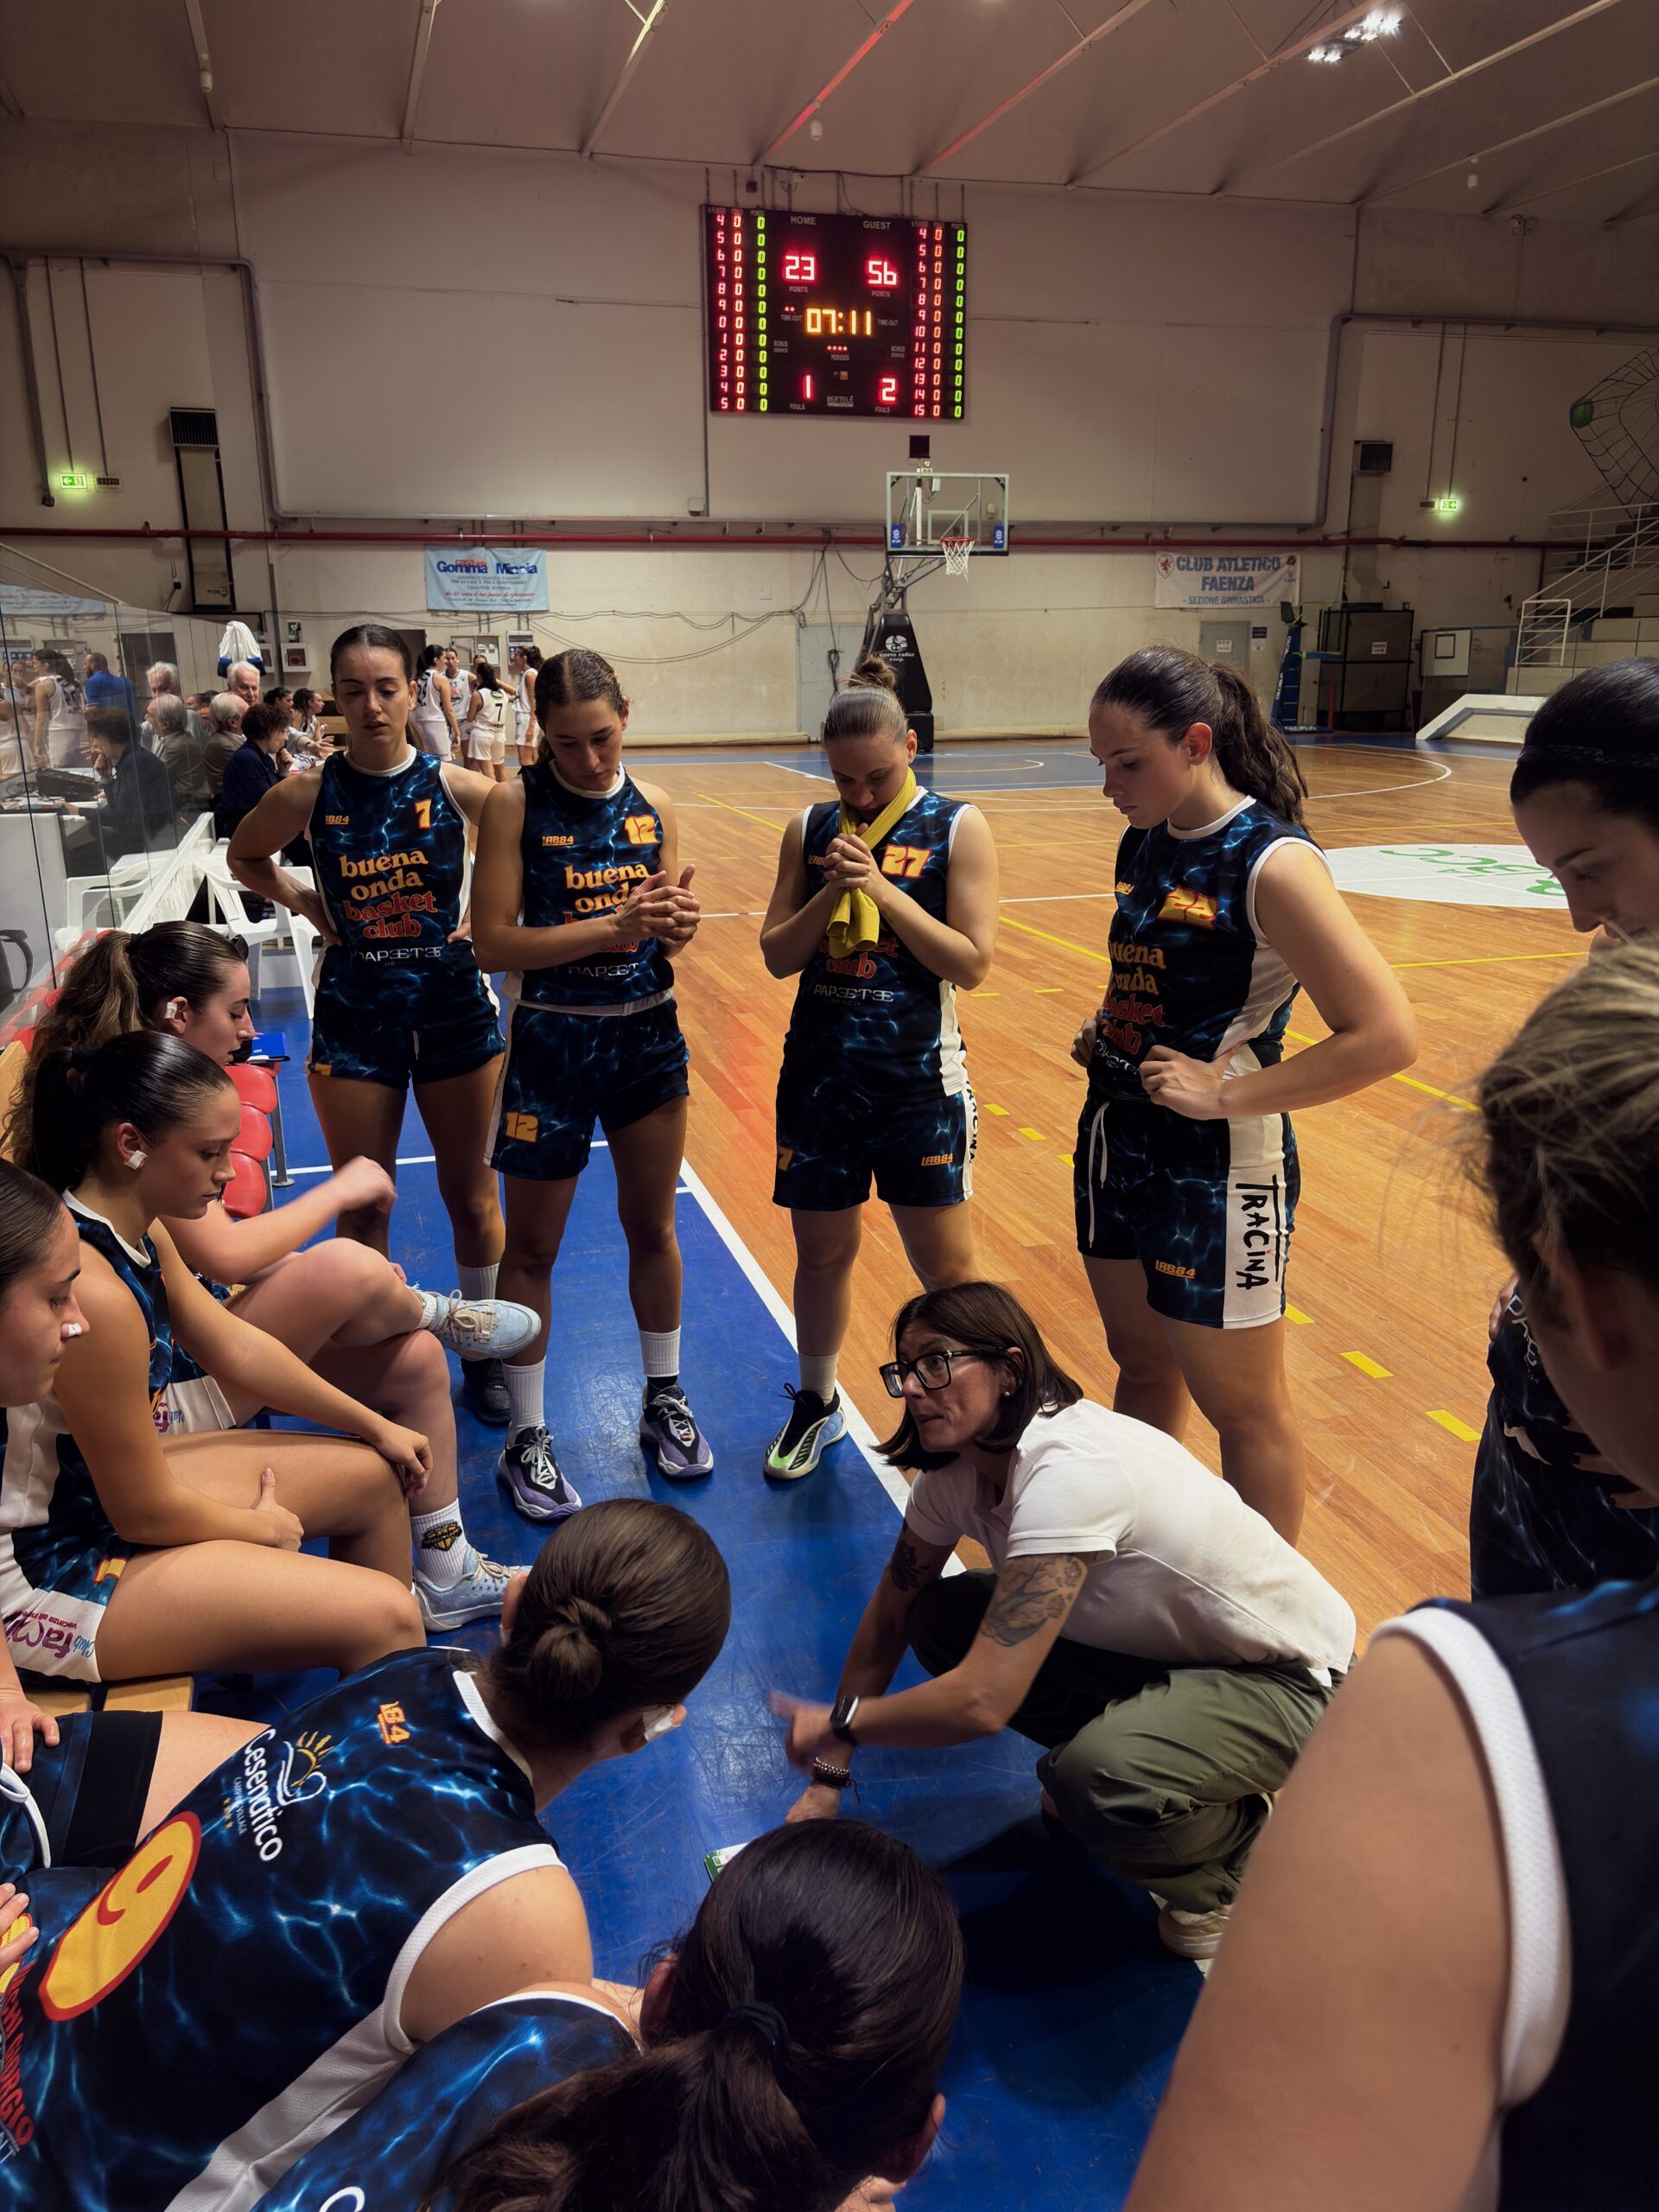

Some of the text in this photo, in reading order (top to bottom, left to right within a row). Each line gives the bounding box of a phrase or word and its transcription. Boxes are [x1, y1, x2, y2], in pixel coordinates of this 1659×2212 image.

[716, 215, 766, 230] 4 0 0
[791, 215, 817, 226] HOME
[862, 220, 891, 230] GUEST
[717, 232, 766, 247] 5 0 0
[919, 228, 965, 242] 4 0 0
[717, 249, 766, 264] 6 0 0
[918, 245, 965, 258] 5 0 0
[718, 265, 766, 281] 7 0 0
[785, 255, 816, 281] 23
[868, 260, 898, 286] 56
[918, 261, 964, 275] 6 0 0
[718, 283, 766, 297] 8 0 0
[919, 277, 964, 291] 7 0 0
[718, 299, 766, 315] 9 0 0
[918, 294, 964, 308] 8 0 0
[718, 315, 767, 331] 0 0 0
[806, 308, 872, 335] 07:11
[918, 309, 963, 324] 9 0 0
[722, 333, 767, 347] 1 0 0
[915, 326, 963, 340] 10 0 0
[720, 348, 767, 363] 2 0 0
[915, 342, 963, 355] 11 0 0
[721, 365, 767, 379] 3 0 0
[914, 358, 963, 372] 12 0 0
[914, 373, 963, 387] 13 0 0
[721, 382, 768, 396] 4 0 0
[881, 378, 897, 402] 2
[914, 389, 963, 403] 14 0 0
[721, 397, 768, 411] 5 0 0
[914, 404, 962, 418] 15 0 0
[436, 561, 487, 574] Gomma
[1176, 556, 1281, 573] CLUB ATLETICO
[1200, 575, 1255, 592] FAENZA
[1188, 596, 1220, 605] SEZIONE
[495, 702, 503, 722] 7
[415, 798, 432, 830] 7
[625, 814, 659, 845] 12
[339, 849, 429, 879] buena
[880, 843, 932, 879] 27
[350, 868, 424, 900] onda
[563, 863, 651, 890] buena
[575, 881, 632, 914] ond
[342, 890, 438, 922] basket
[1157, 885, 1219, 931] 22
[363, 913, 422, 938] club
[825, 953, 876, 979] club
[505, 1111, 539, 1143] 12
[1235, 1173, 1281, 1290] TRACINA
[48, 1616, 78, 1630] vacanze
[73, 1635, 95, 1658] Club
[245, 1728, 283, 1861] Cesenatico
